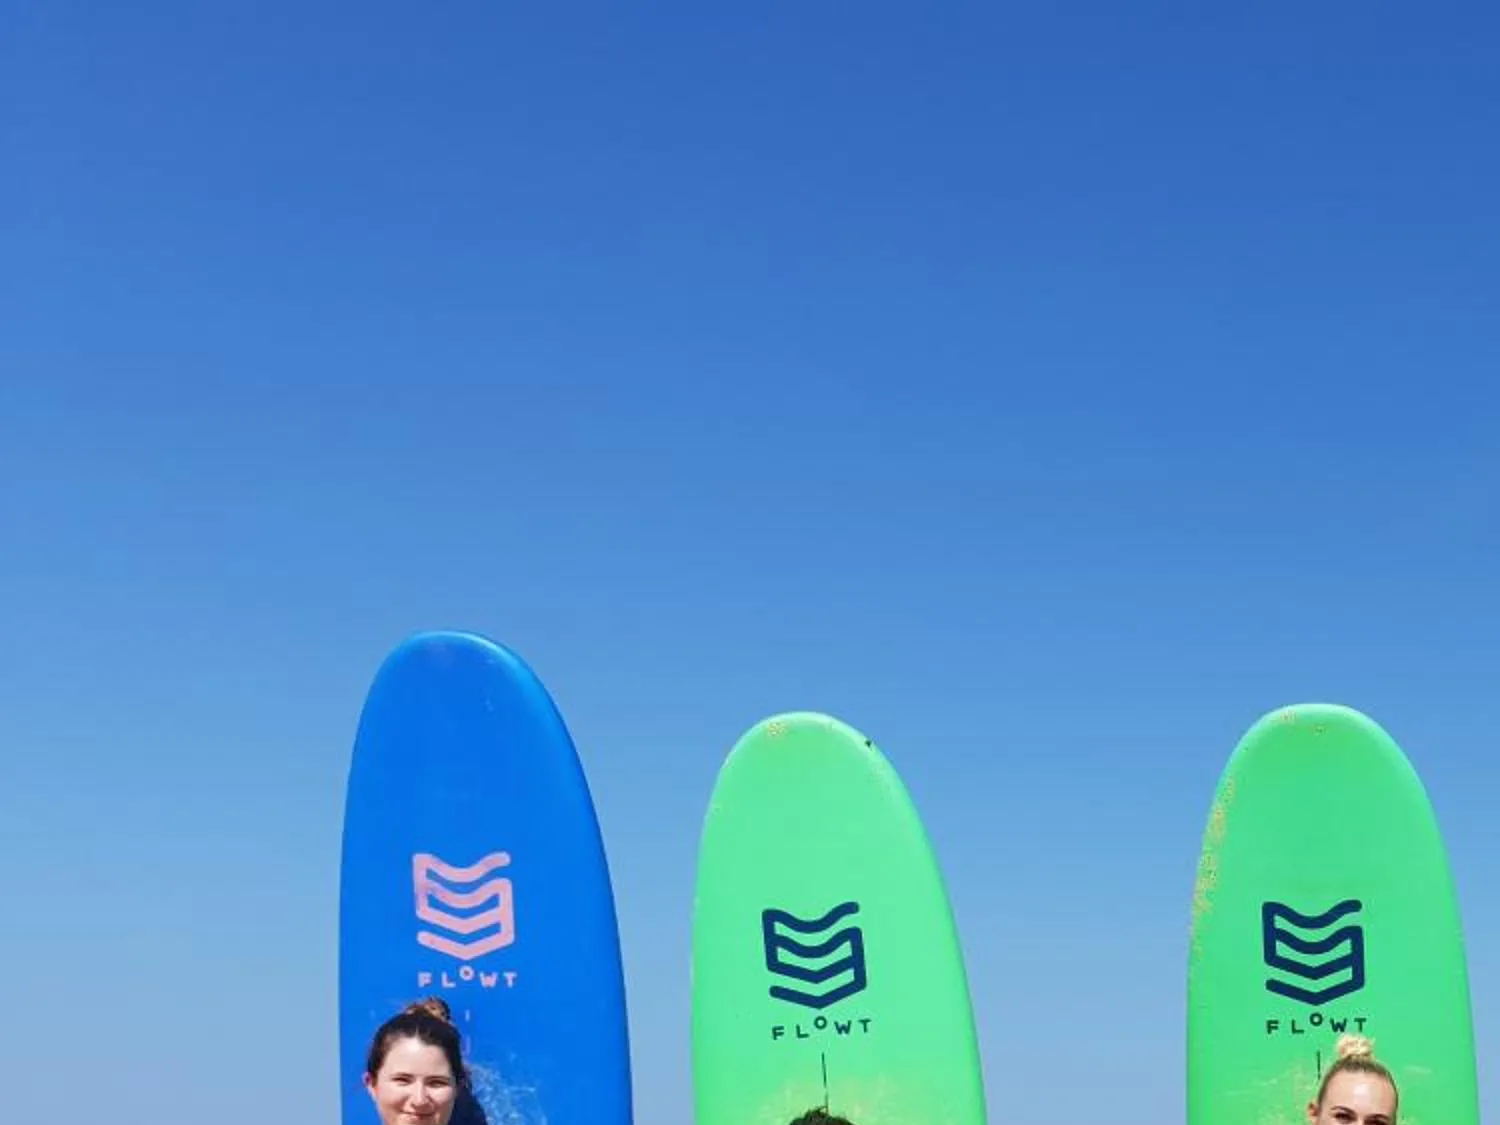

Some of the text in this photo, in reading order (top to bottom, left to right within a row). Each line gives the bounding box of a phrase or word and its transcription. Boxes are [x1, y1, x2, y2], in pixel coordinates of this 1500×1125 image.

[417, 966, 518, 988] FLOWT
[771, 1016, 872, 1040] FLOWT
[1265, 1013, 1368, 1034] FLOWT
